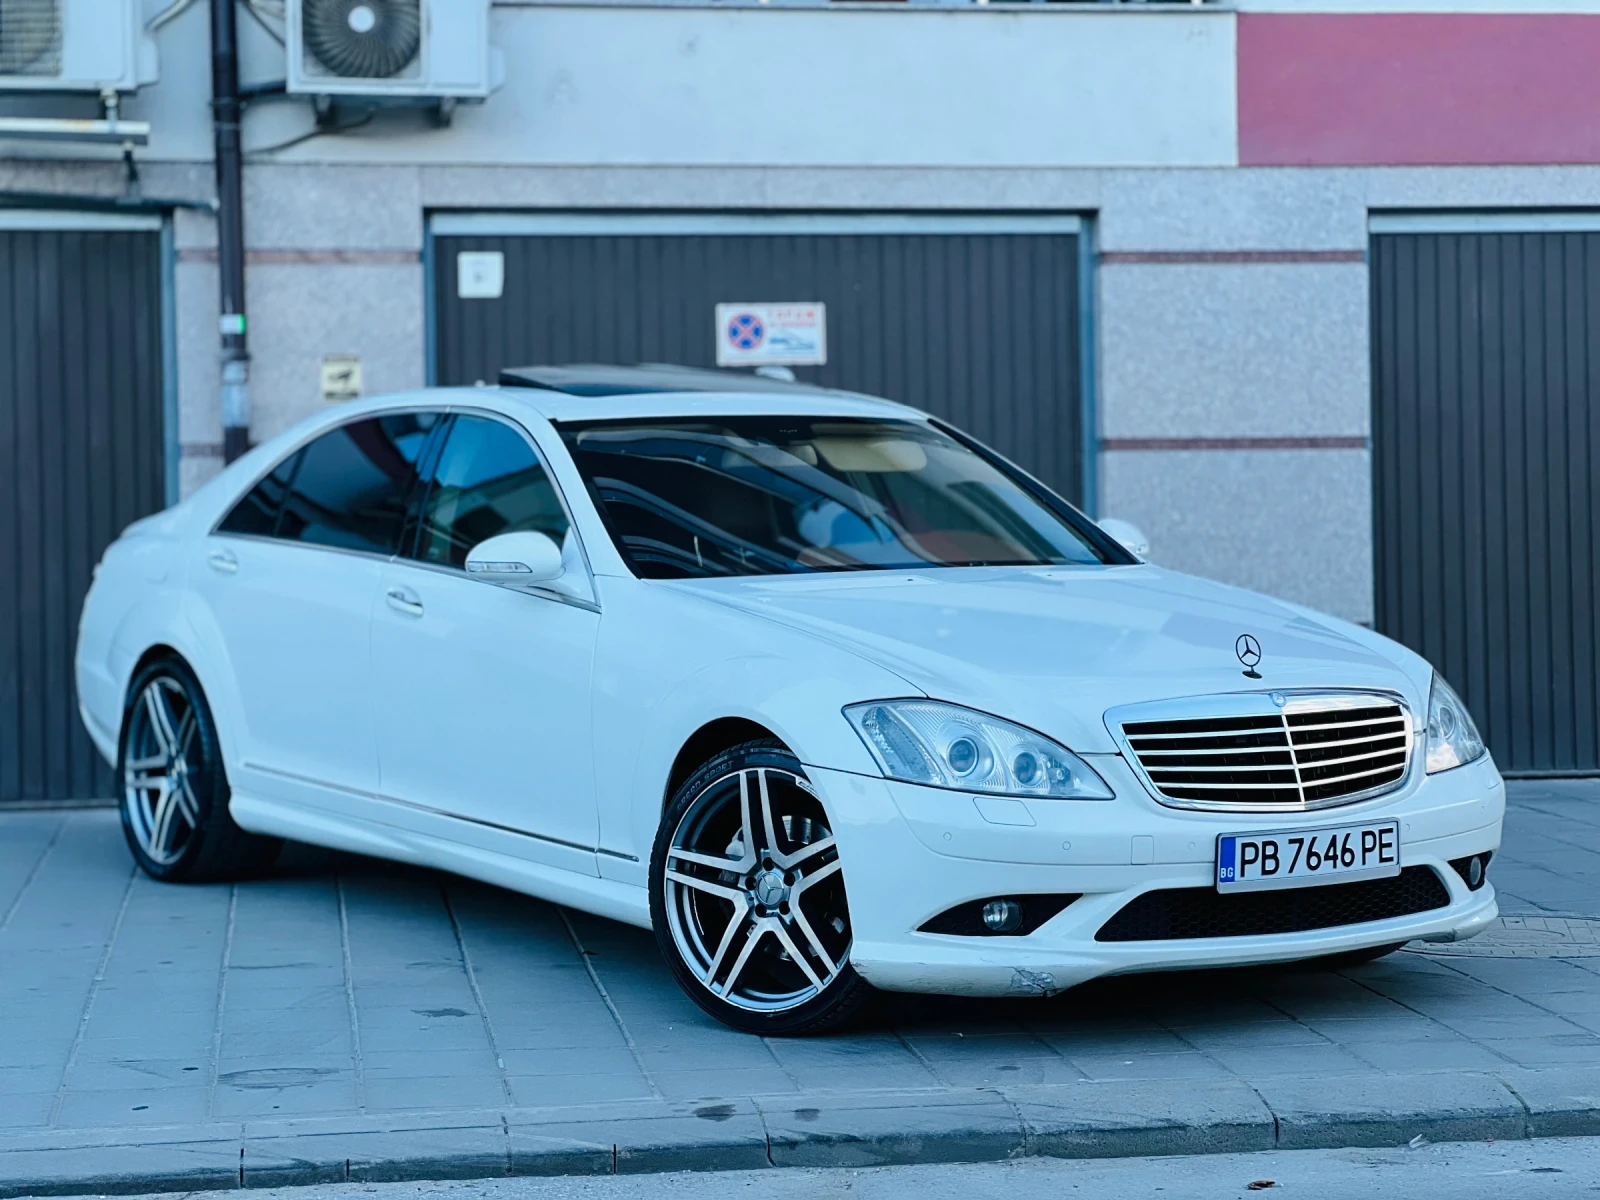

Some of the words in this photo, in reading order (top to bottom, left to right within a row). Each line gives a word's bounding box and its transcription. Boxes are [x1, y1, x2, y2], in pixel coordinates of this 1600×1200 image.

[1240, 840, 1280, 878] PB
[1288, 833, 1355, 874] 7646
[1361, 828, 1394, 866] PE
[1220, 867, 1234, 878] BG
